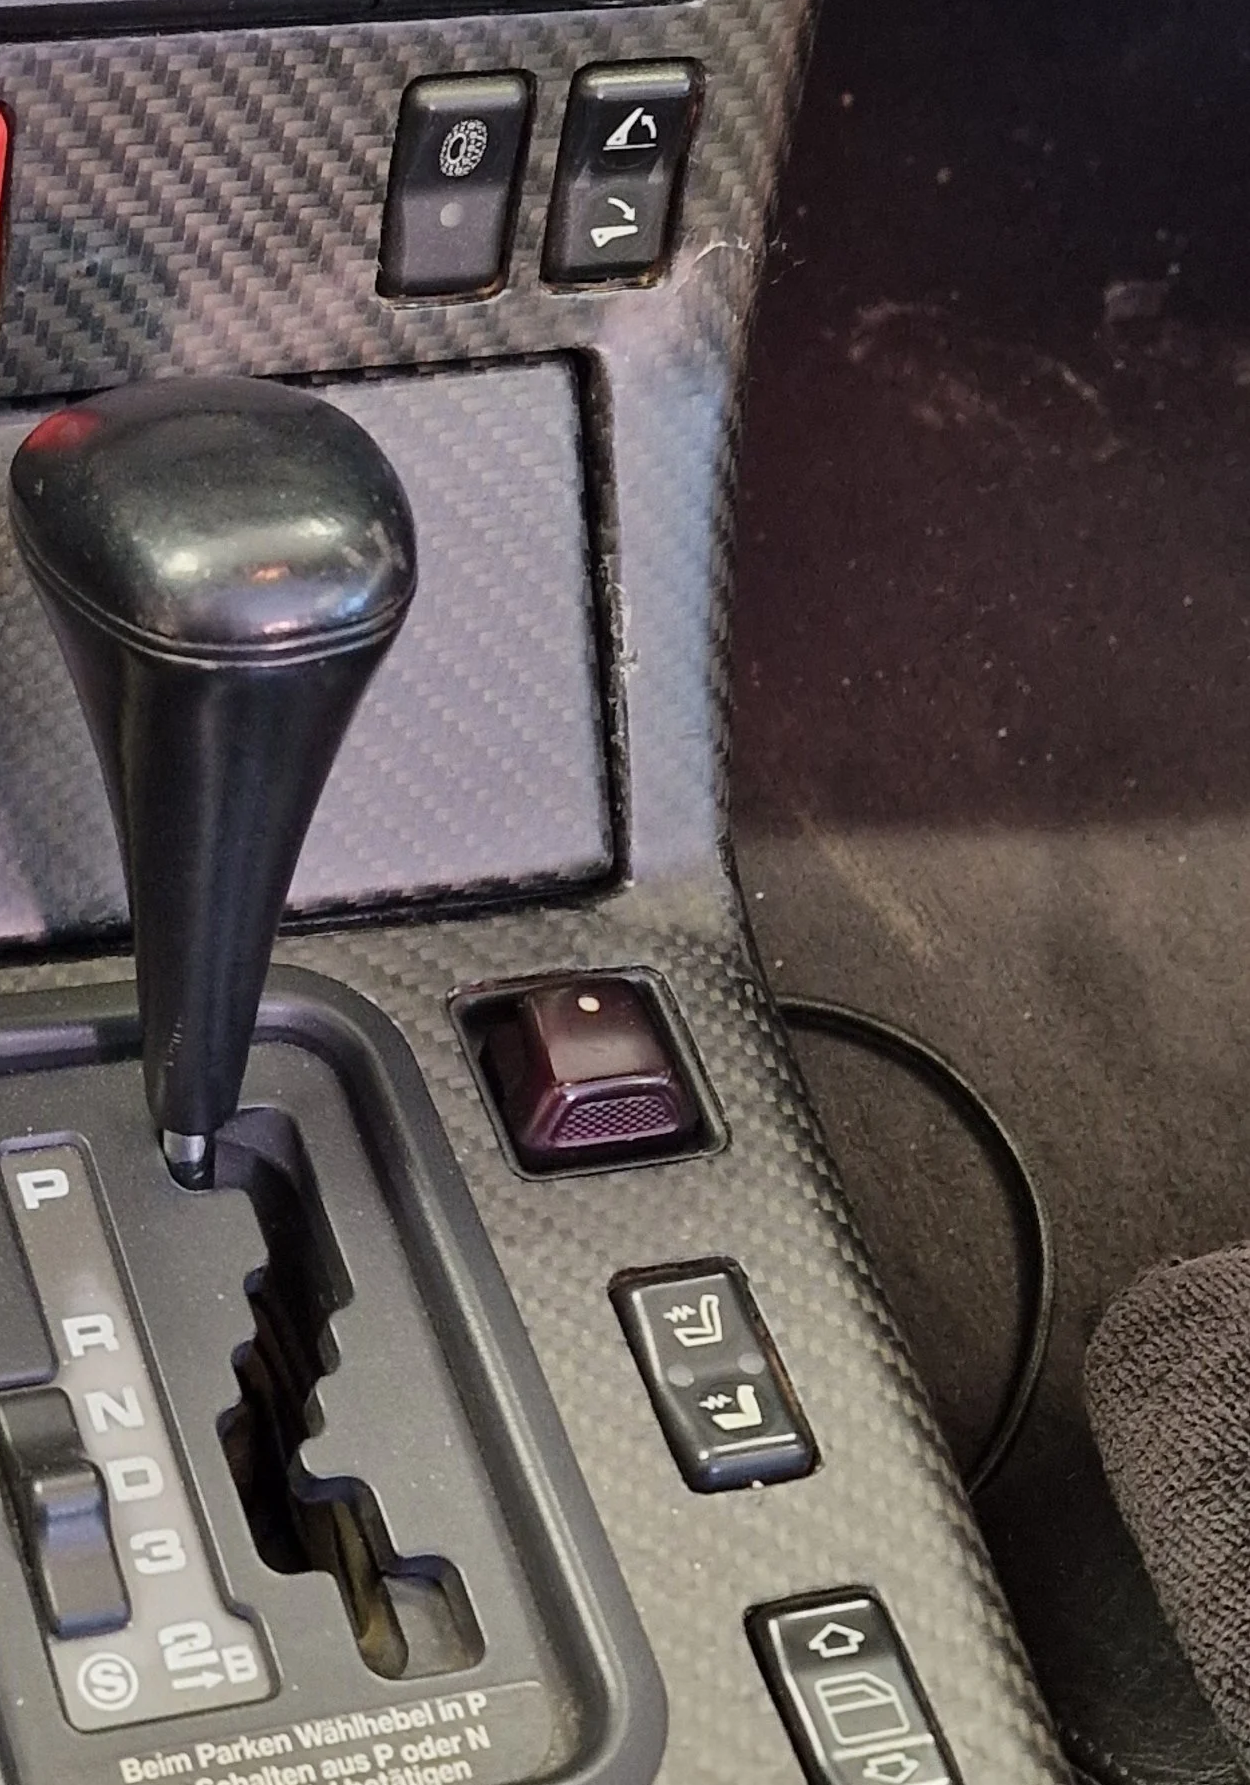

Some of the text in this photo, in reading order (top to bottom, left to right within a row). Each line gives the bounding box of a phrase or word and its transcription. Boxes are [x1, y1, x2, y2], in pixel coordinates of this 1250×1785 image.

[16, 1168, 70, 1211] P
[62, 1313, 119, 1359] R
[87, 1390, 145, 1433] N
[107, 1457, 165, 1502] D
[129, 1527, 187, 1578] 3
[156, 1620, 220, 1670] 2
[219, 1642, 259, 1682] B
[118, 1691, 488, 1785] Beim Parken Wählhebel in P
[320, 1749, 371, 1781] aus
[372, 1741, 396, 1769] P
[400, 1733, 463, 1765] oder
[463, 1723, 492, 1752] N
